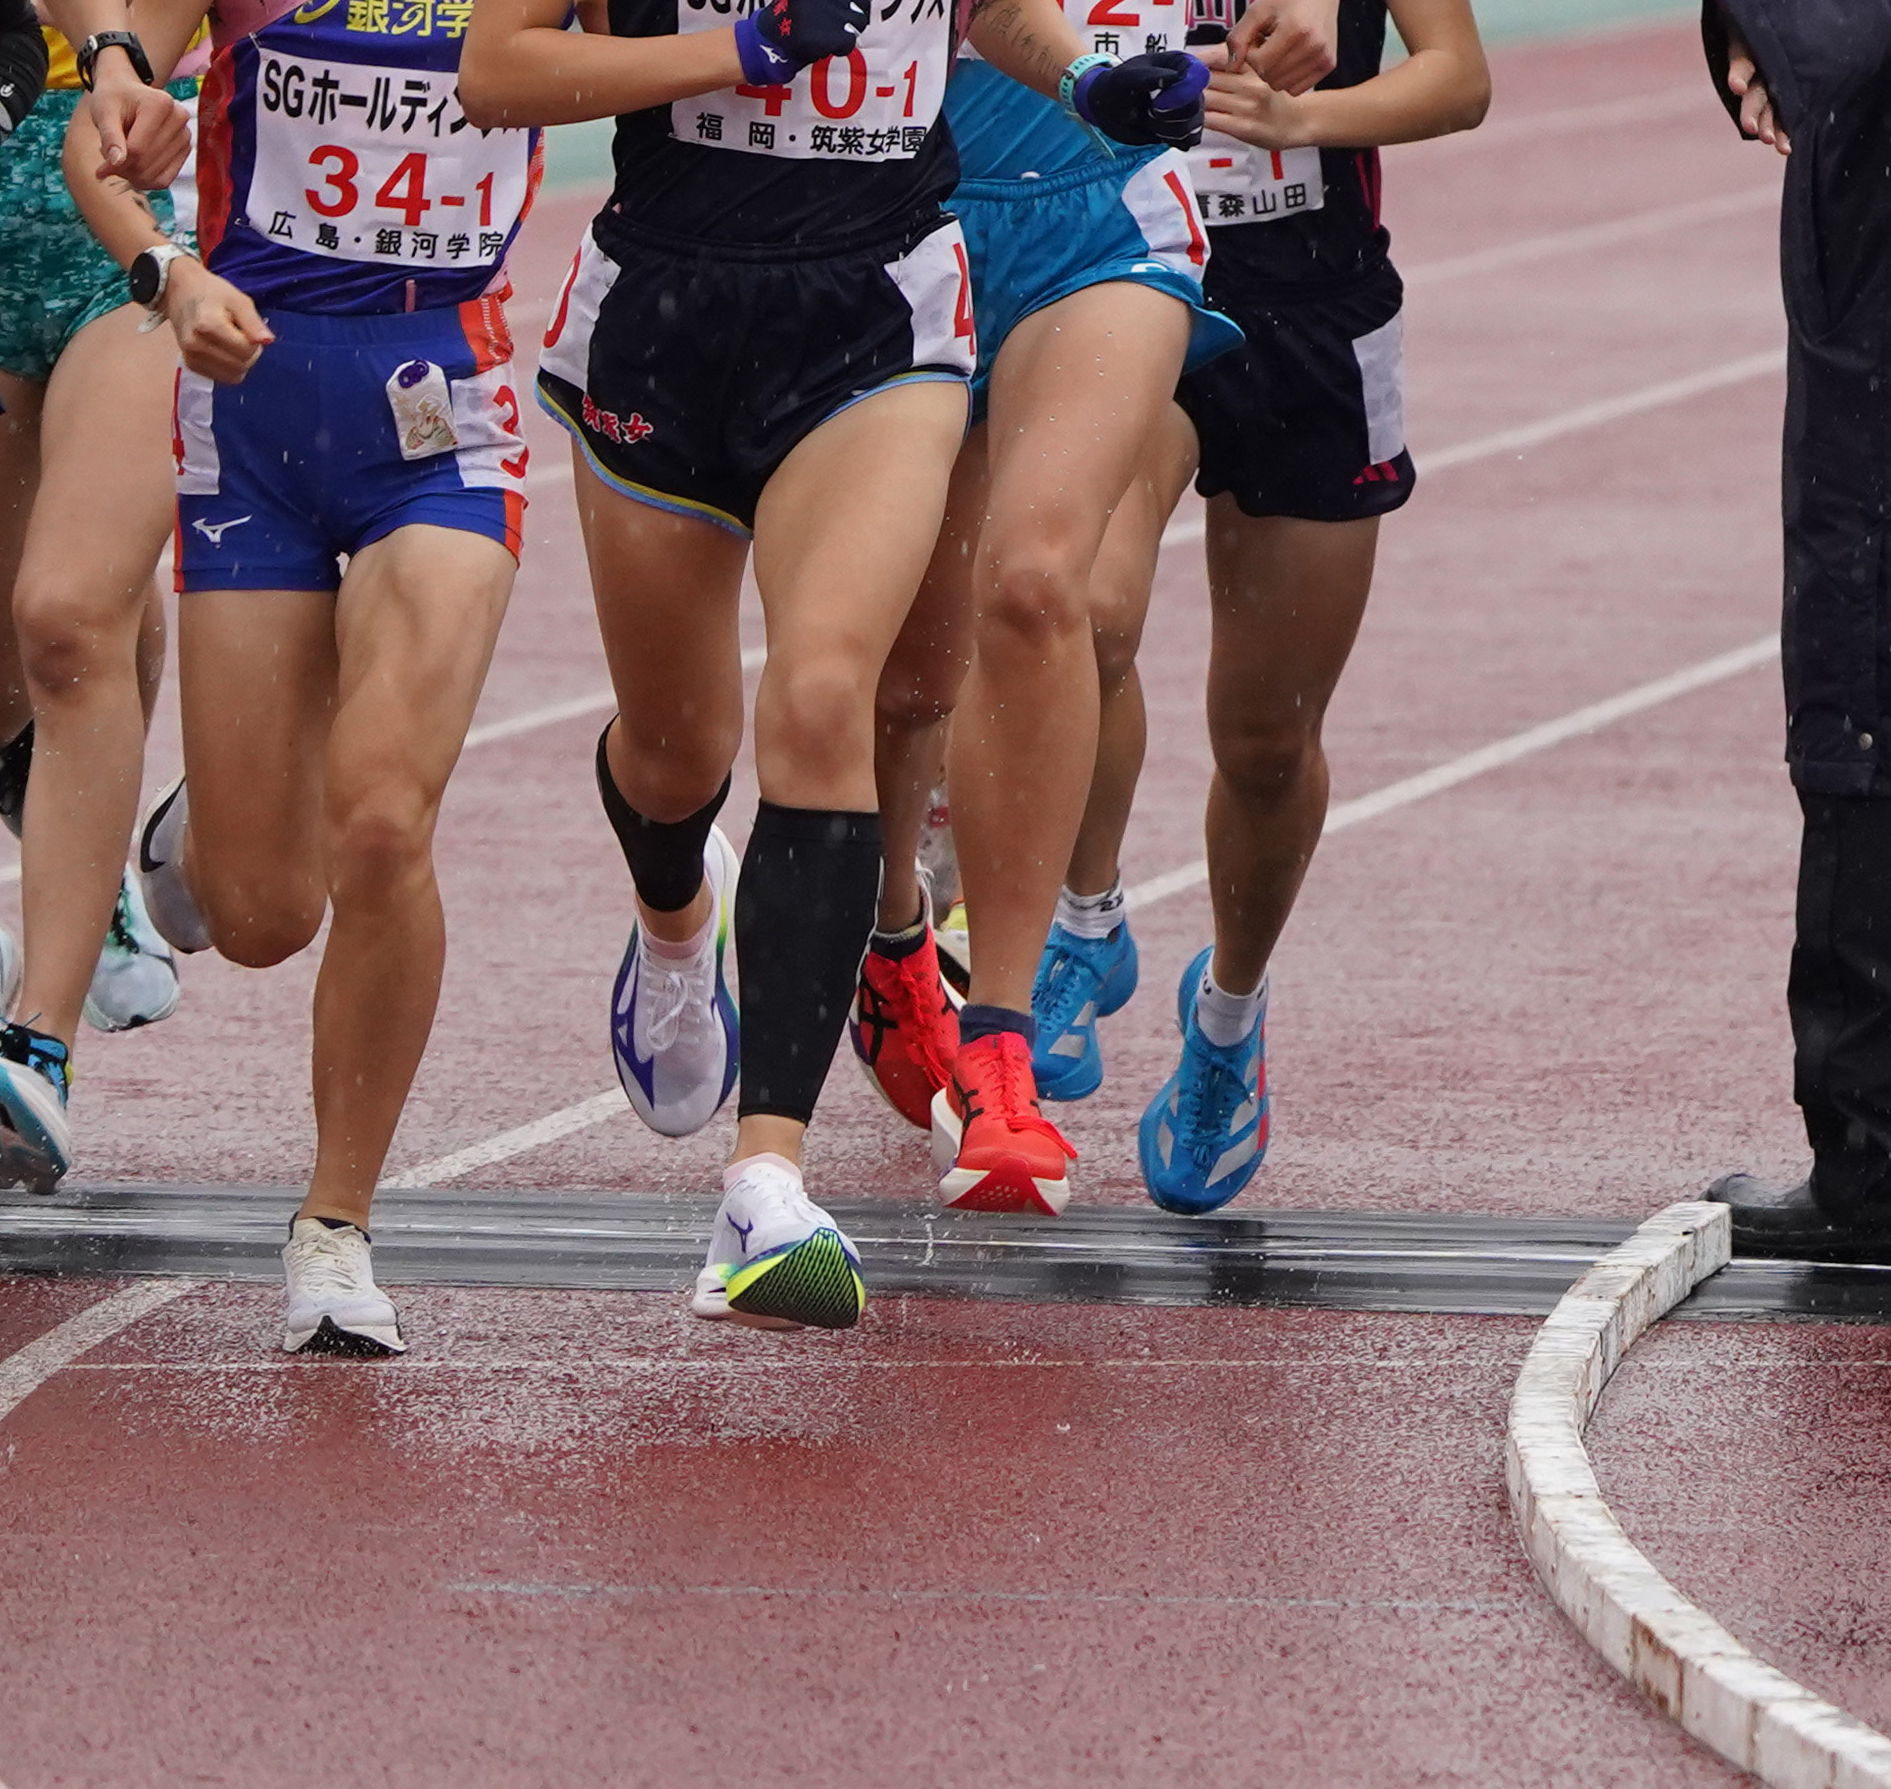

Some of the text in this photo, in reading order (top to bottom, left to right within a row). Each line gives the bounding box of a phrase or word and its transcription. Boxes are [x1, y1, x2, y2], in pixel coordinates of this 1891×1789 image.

[695, 112, 928, 156] 福岡・筑紫女学園
[305, 144, 495, 227] 34-1
[268, 211, 504, 260] 広島・銀河学院
